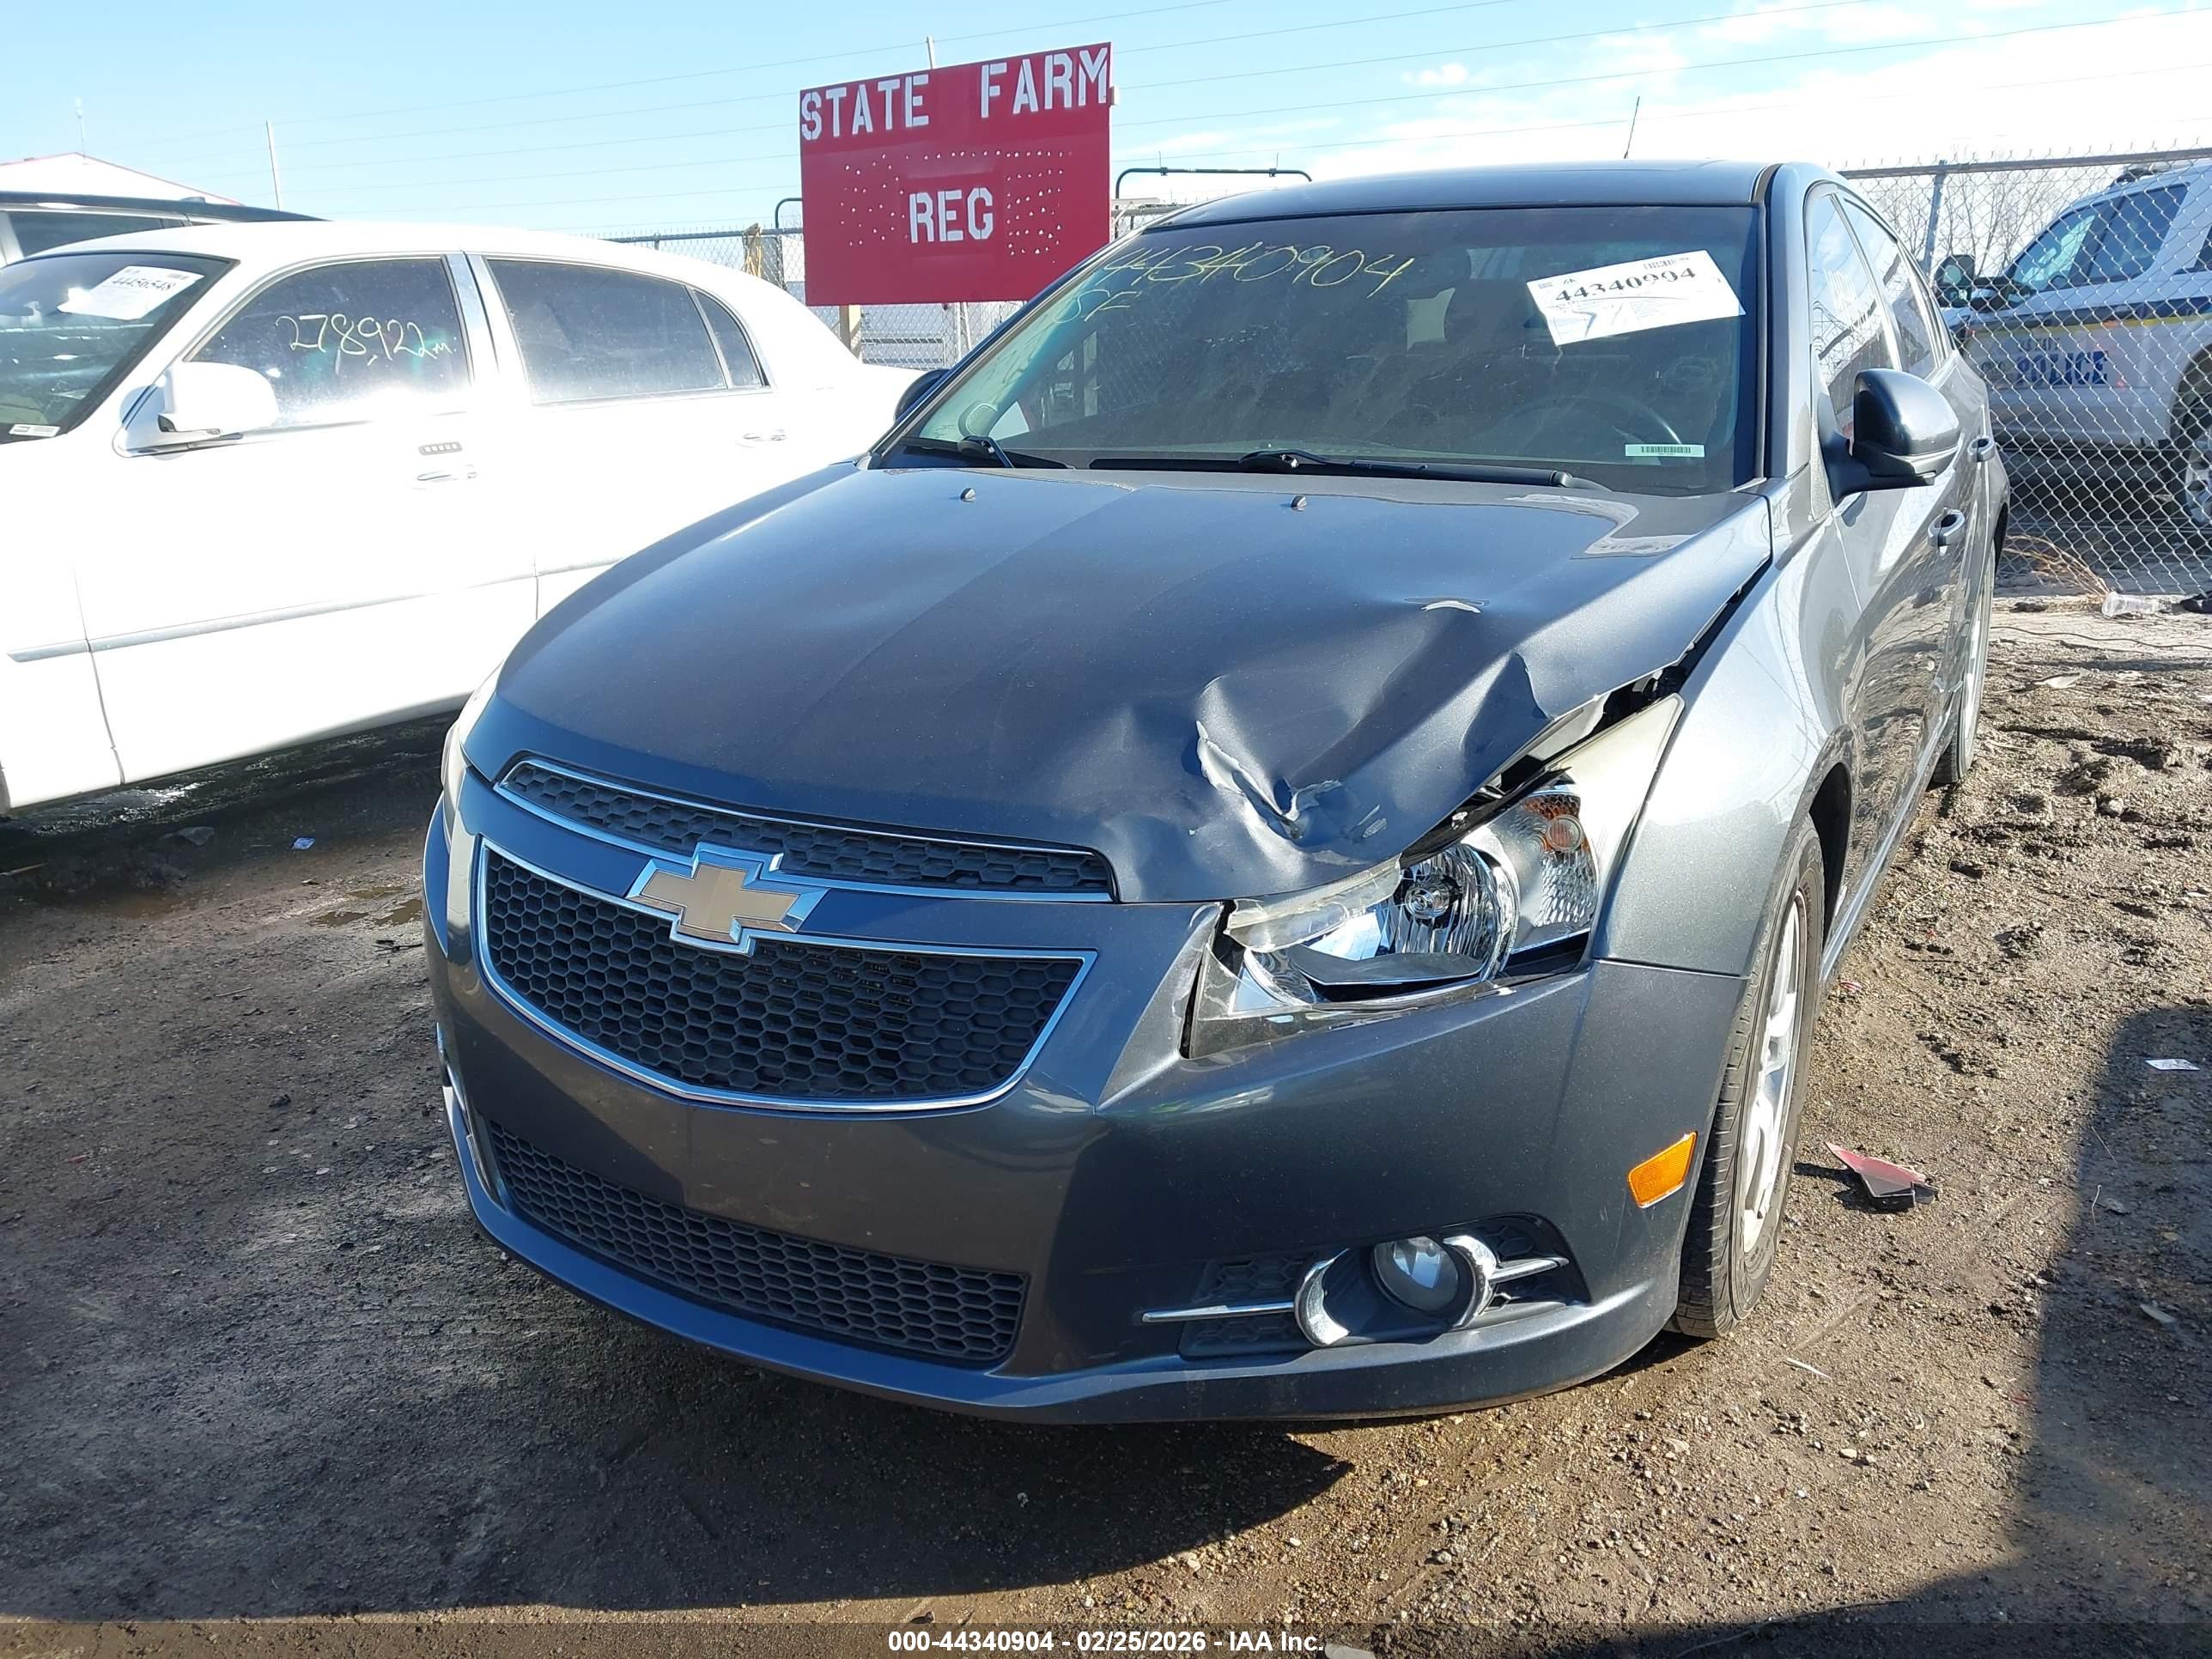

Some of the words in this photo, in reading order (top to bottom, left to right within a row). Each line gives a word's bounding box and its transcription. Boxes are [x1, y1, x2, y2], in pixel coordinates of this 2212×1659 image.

[801, 74, 929, 140] STATE
[981, 47, 1108, 118] FARM
[908, 186, 994, 244] REG
[1095, 241, 1415, 299] 44340904
[2015, 350, 2109, 386] POLICE
